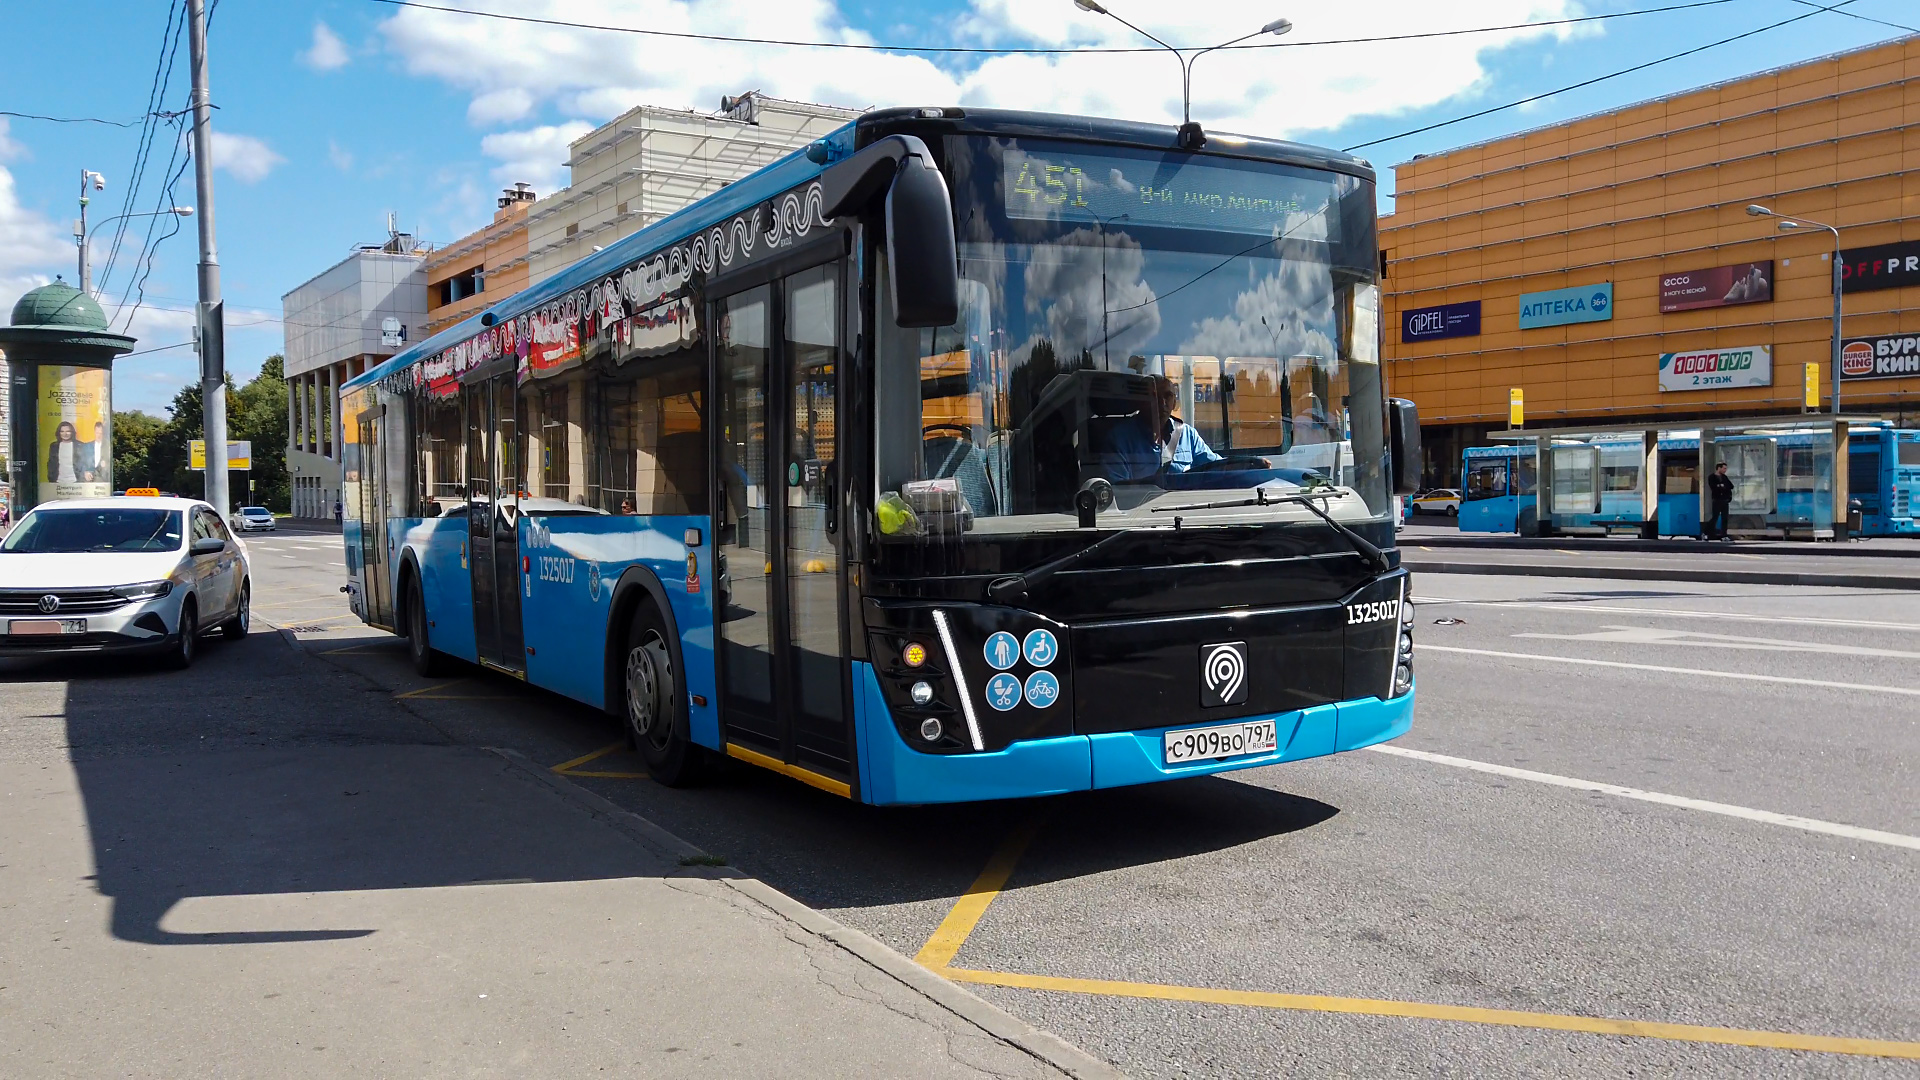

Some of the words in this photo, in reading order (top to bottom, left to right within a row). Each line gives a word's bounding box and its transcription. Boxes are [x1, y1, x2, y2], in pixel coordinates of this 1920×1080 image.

[1014, 162, 1088, 206] 451
[1664, 276, 1690, 287] ecco
[1522, 298, 1586, 318] АПТЕКА
[1843, 352, 1872, 360] BURGER
[1843, 359, 1872, 368] KING
[1692, 375, 1700, 385] 2
[1703, 375, 1732, 385] этаж
[539, 556, 574, 584] 1325017
[1347, 599, 1399, 625] 1325017
[1245, 724, 1271, 744] 797
